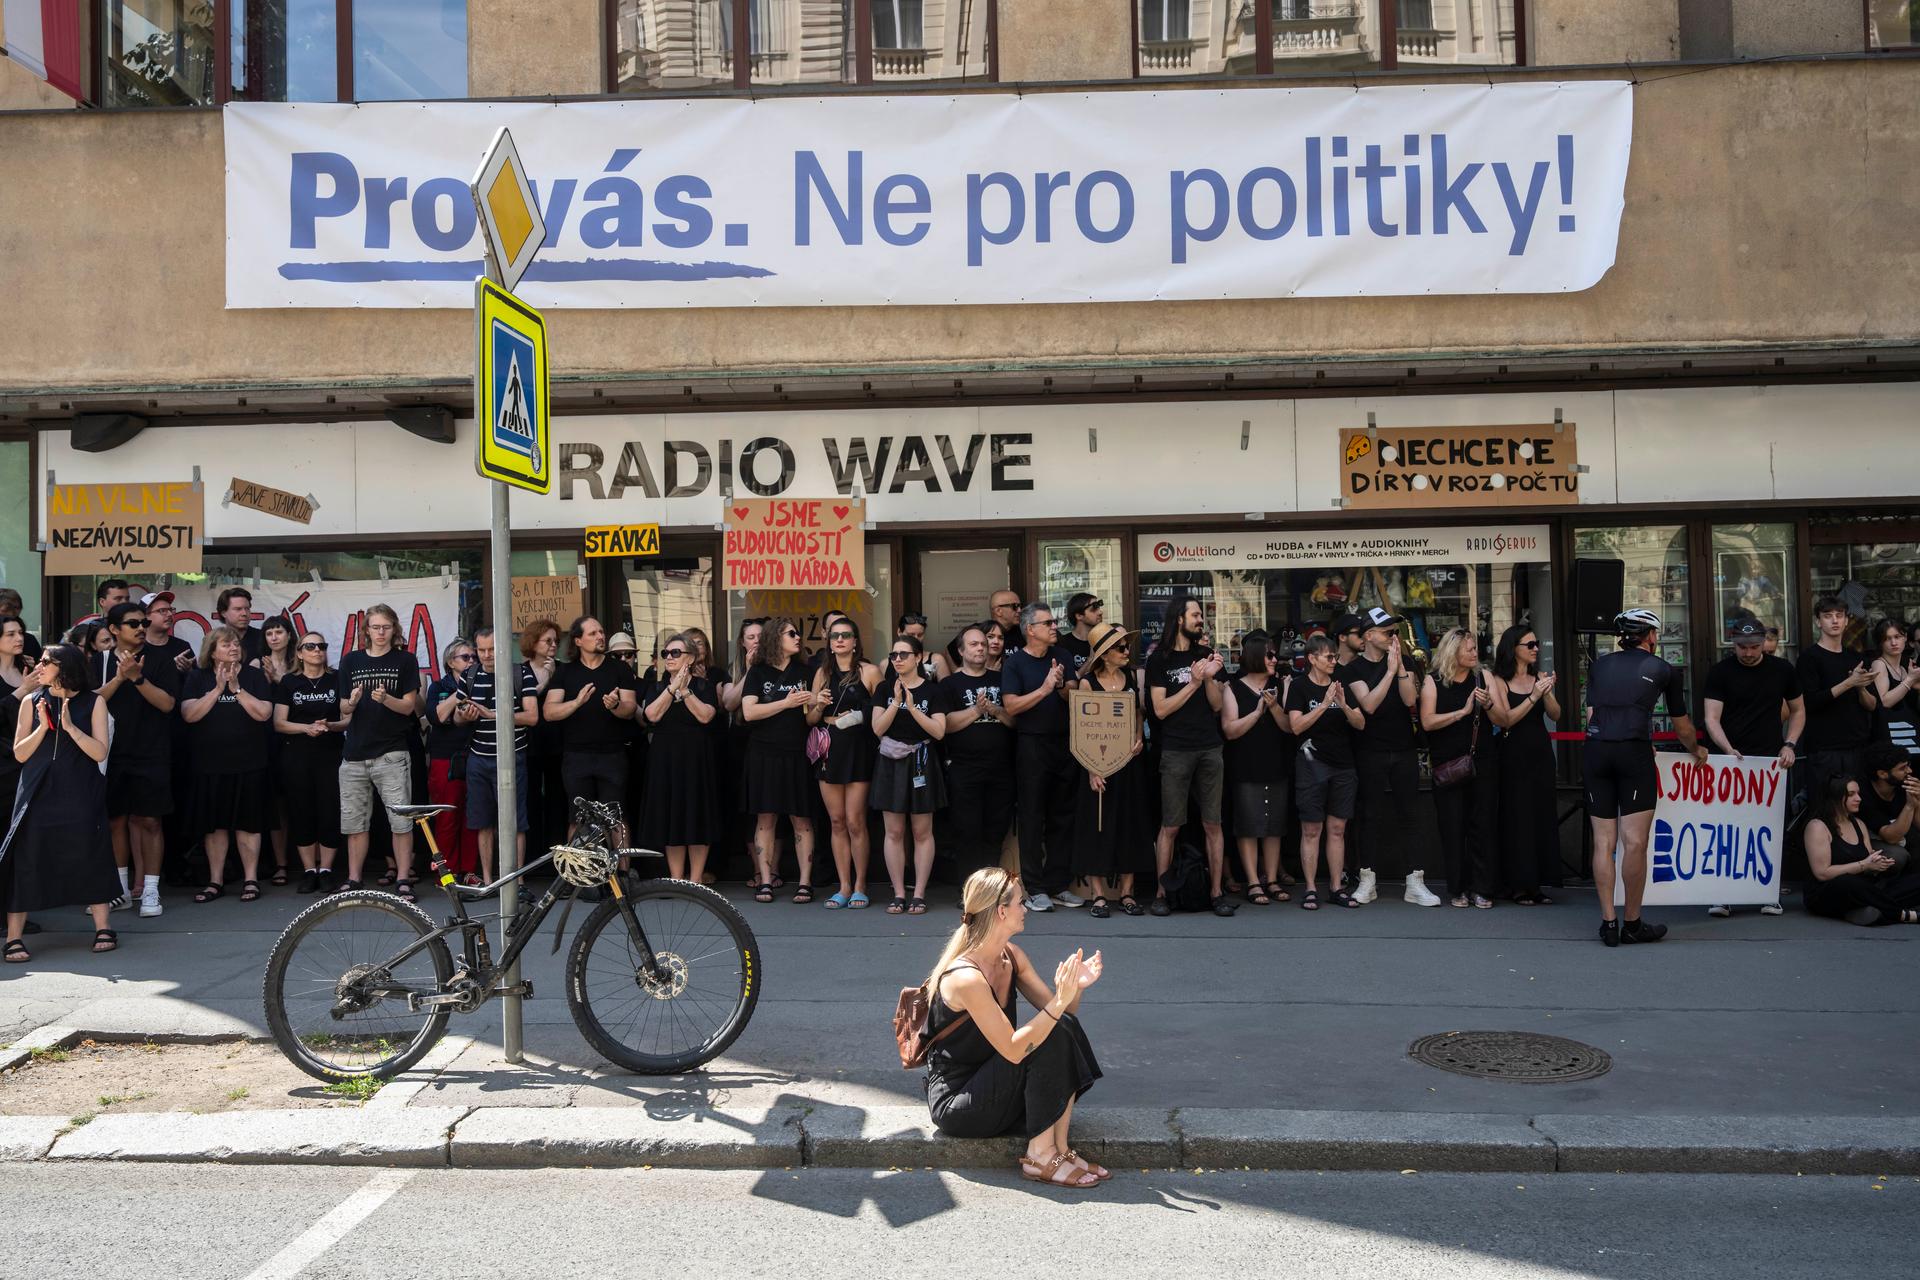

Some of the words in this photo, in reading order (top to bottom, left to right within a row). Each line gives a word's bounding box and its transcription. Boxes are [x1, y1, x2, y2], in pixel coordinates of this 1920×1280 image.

[290, 151, 477, 252] Pro
[795, 149, 932, 246] Ne
[967, 168, 1135, 266] pro
[1170, 133, 1576, 264] politiky!
[559, 436, 797, 500] RADIO
[822, 433, 1035, 494] WAVE
[233, 480, 269, 508] WAVE
[1352, 470, 1418, 494] DÍRY
[53, 486, 90, 515] NA
[763, 501, 822, 527] JSME
[53, 521, 193, 549] NEZÁVISLOSTI
[585, 526, 659, 553] STÁVKA
[1266, 542, 1304, 551] HUDBA
[1316, 541, 1349, 550] FILMY
[1361, 539, 1429, 549] AUDIOKNIHY
[1176, 545, 1235, 557] Multiland
[1356, 550, 1383, 558] TRIČKA
[726, 559, 785, 586] TOHOTO
[790, 556, 856, 586] NÁRODA
[523, 582, 530, 597] A
[1086, 732, 1121, 740] POPLATKY
[1667, 760, 1780, 808] SVOBODNÝ
